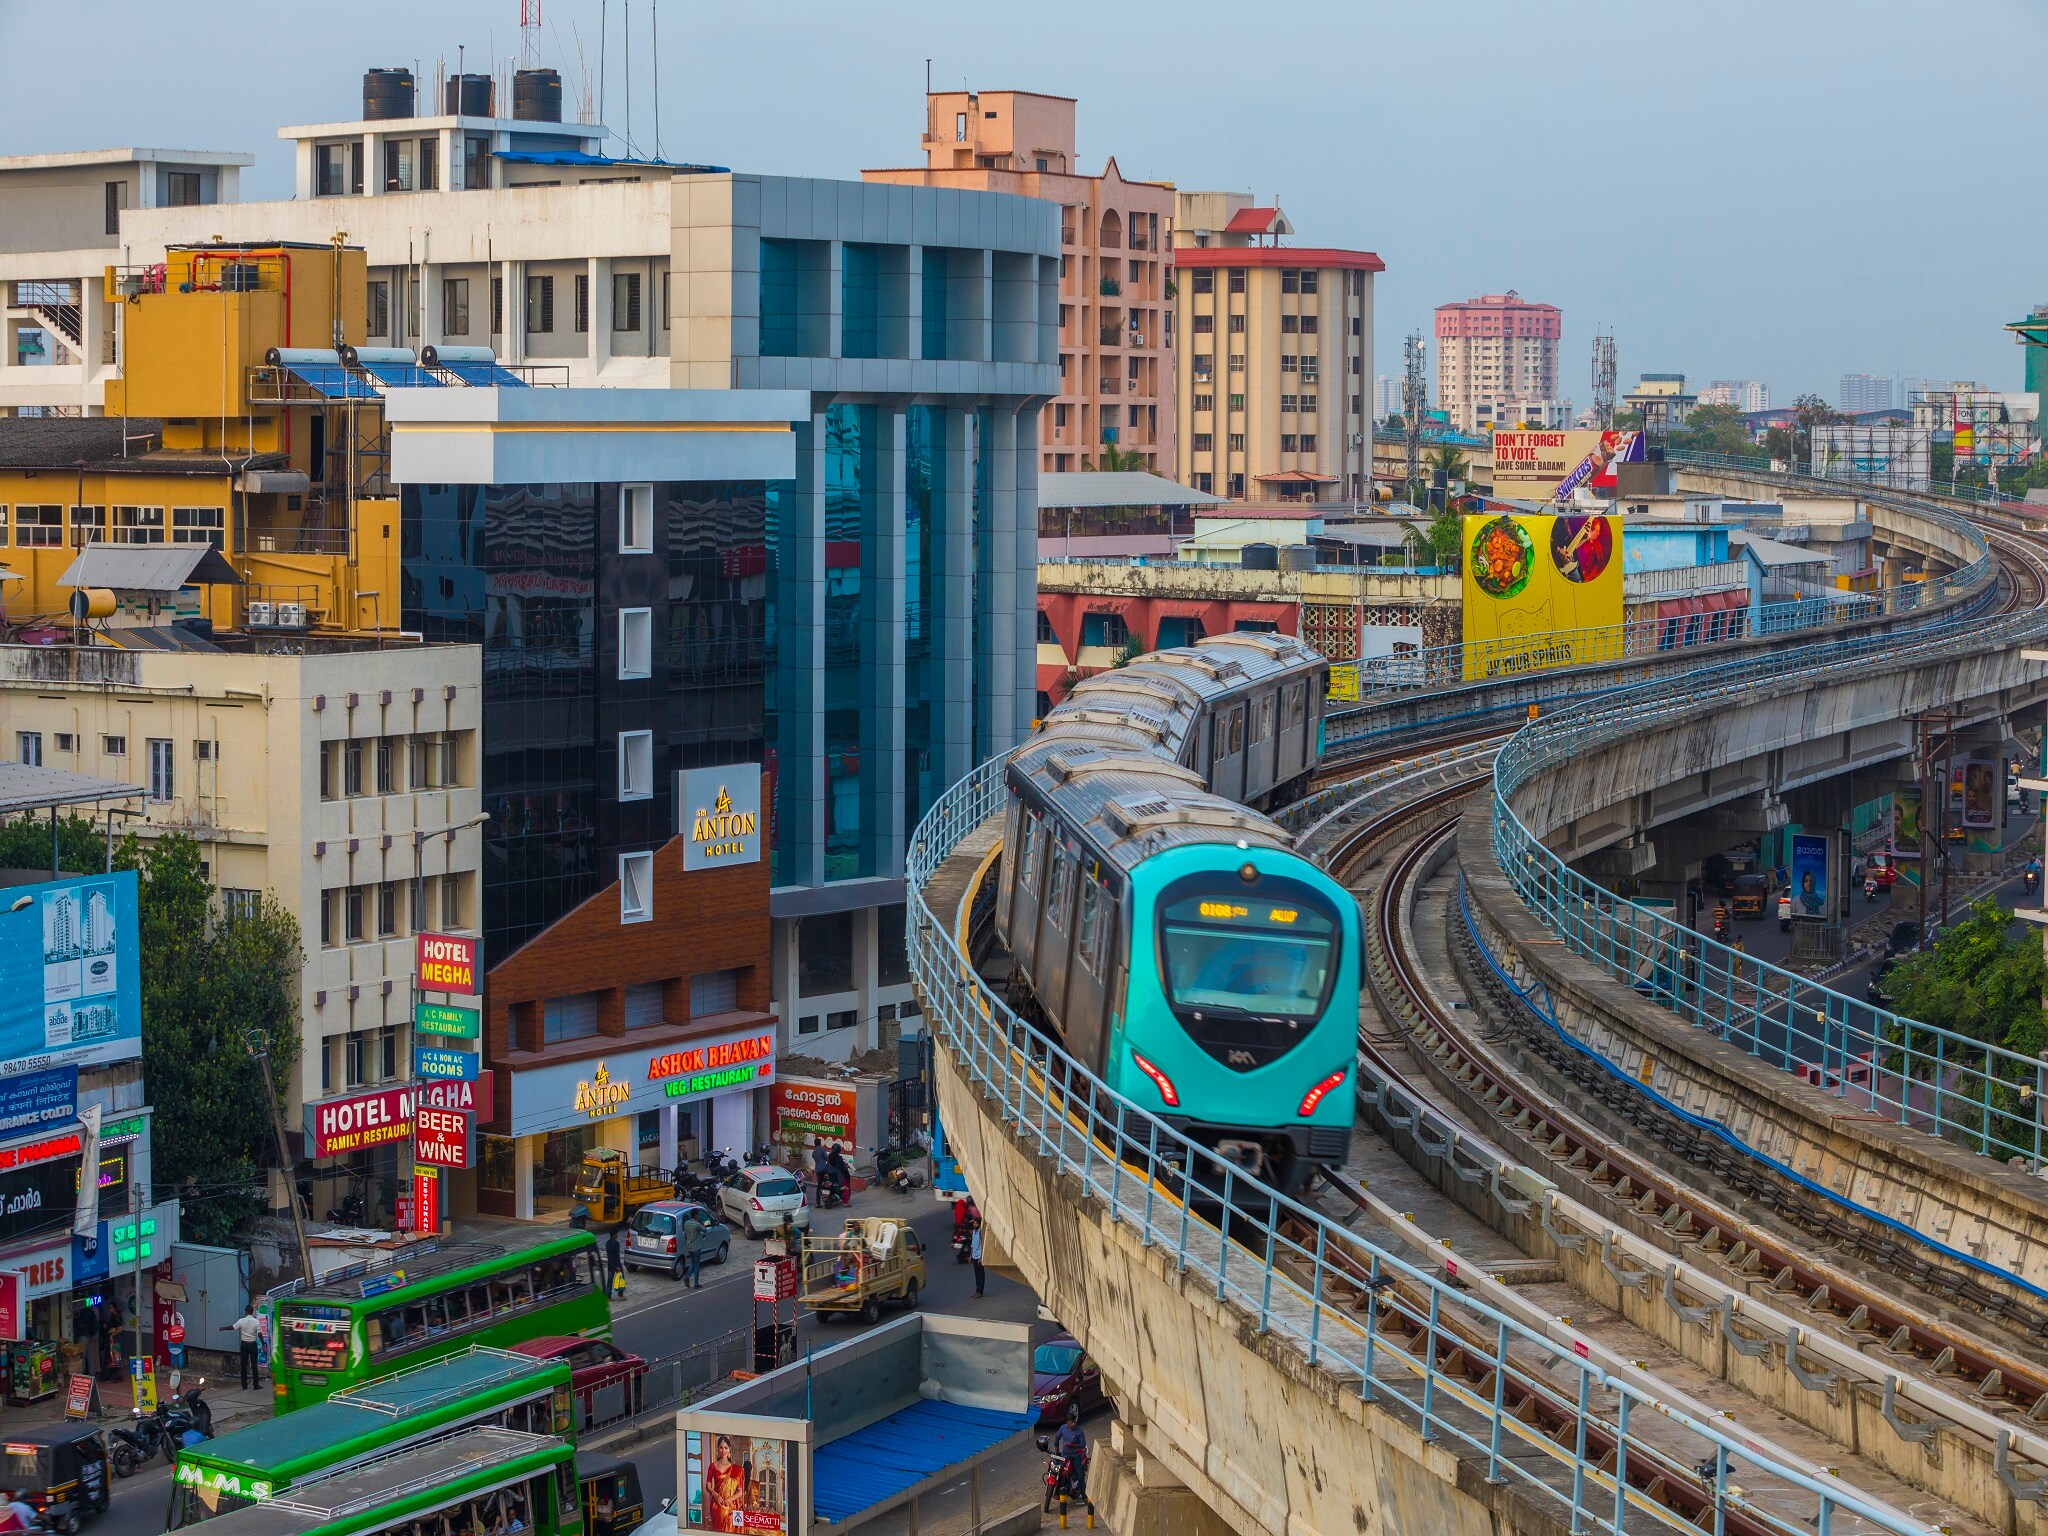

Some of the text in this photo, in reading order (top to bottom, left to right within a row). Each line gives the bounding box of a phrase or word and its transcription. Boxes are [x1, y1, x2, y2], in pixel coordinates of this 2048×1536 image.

[1495, 433, 1566, 447] DON'T FORGET
[1495, 447, 1539, 461] TO VOTE.
[1495, 461, 1566, 471] HAVE SOME BADAM!
[1556, 458, 1593, 500] SNICKERS
[1501, 651, 1530, 674] YOUR
[1531, 643, 1572, 669] SPIRITS
[693, 812, 756, 843] ANTON
[705, 842, 744, 857] HOTEL
[424, 940, 470, 963] HOTEL
[421, 962, 472, 986] MEGHA
[49, 1015, 68, 1026] abode
[438, 1010, 463, 1022] FAMILY
[421, 1020, 466, 1035] RESTAURANT
[3, 1059, 27, 1074] 98470
[28, 1055, 51, 1070] 55550
[439, 1053, 452, 1063] NON
[647, 1035, 772, 1080] ASHOK BHAVAN
[422, 1061, 463, 1076] ROOMS
[664, 1078, 690, 1098] VEG.
[690, 1065, 757, 1090] RESTAURANT
[9, 1086, 38, 1099] കമ്പനി
[36, 1092, 70, 1106] लिमिटेड
[574, 1081, 630, 1111] ANTON
[785, 1088, 842, 1107] ഹോട്ടൽ
[323, 1081, 473, 1135] HOTEL MGHA
[589, 1105, 618, 1117] HOTEL
[776, 1106, 850, 1125] അശോക് ഭവൻ
[418, 1110, 464, 1134] BEER
[326, 1120, 415, 1152] FAMILY RESTAURA
[437, 1132, 445, 1142] &
[18, 1135, 81, 1164] PHARMA
[418, 1140, 463, 1163] WINE
[83, 1238, 98, 1252] Jio
[85, 1295, 101, 1307] TATA
[134, 1374, 151, 1382] BNL
[139, 1399, 155, 1407] SNL
[744, 1513, 780, 1526] SEEMATTI
